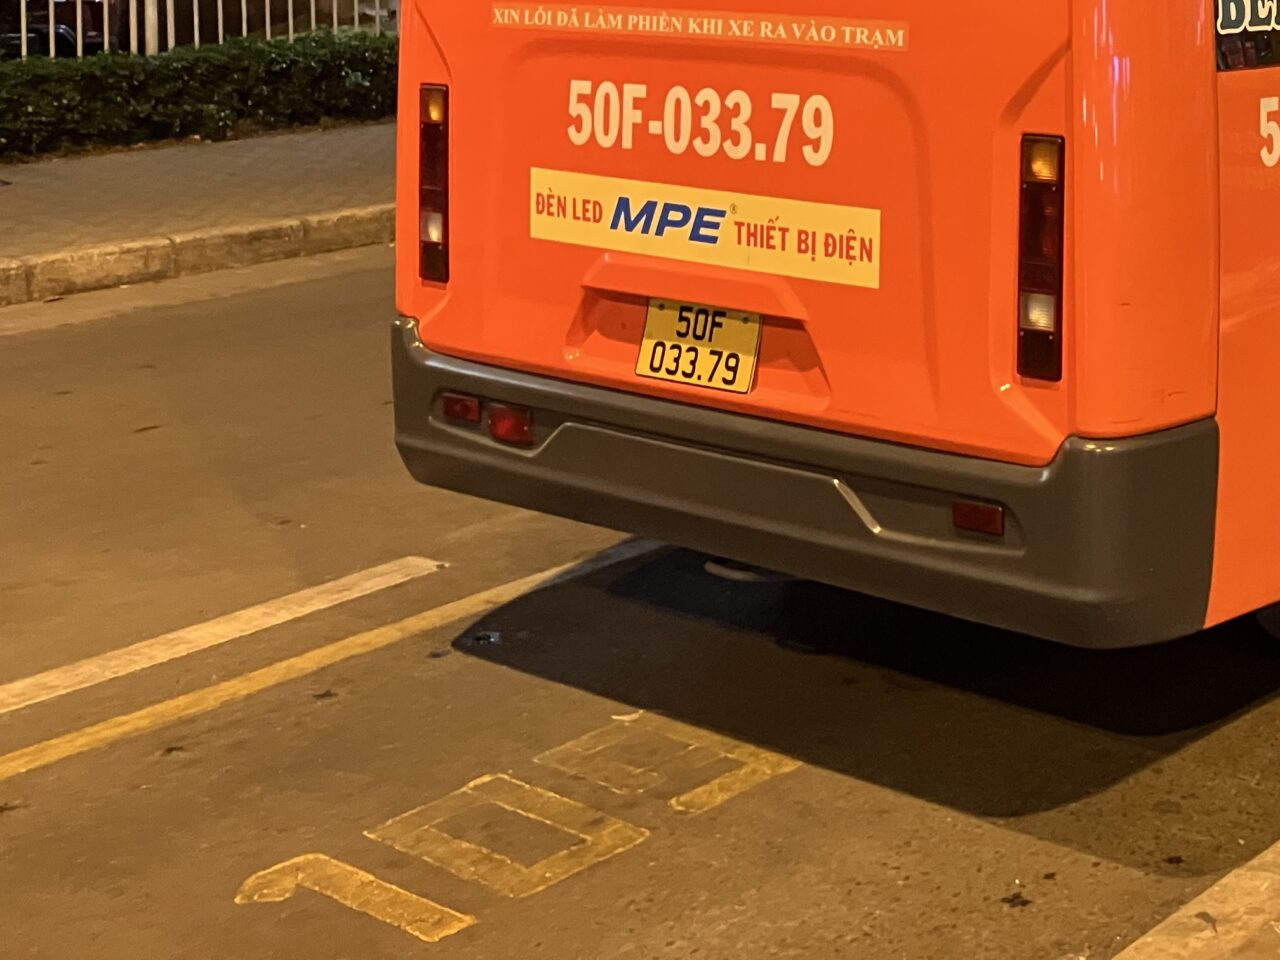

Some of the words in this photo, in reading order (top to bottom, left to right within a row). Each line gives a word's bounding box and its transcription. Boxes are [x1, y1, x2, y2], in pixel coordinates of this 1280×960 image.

[493, 8, 520, 24] XIN
[524, 6, 552, 26] LỖI
[584, 9, 623, 29] LÀM
[688, 17, 723, 35] KHI
[728, 20, 754, 37] XE
[760, 21, 787, 38] RA
[792, 20, 836, 43] VÀO
[841, 26, 905, 49] TRẠM
[567, 79, 834, 167] 50F-033.79
[536, 187, 567, 219] ĐÈN
[572, 197, 603, 223] LED
[610, 196, 728, 245] MPE
[734, 216, 789, 251] THIẾT
[797, 229, 816, 261] BỊ
[824, 228, 873, 266] ĐIỆN
[676, 305, 727, 343] 50F
[649, 340, 741, 387] 033.79
